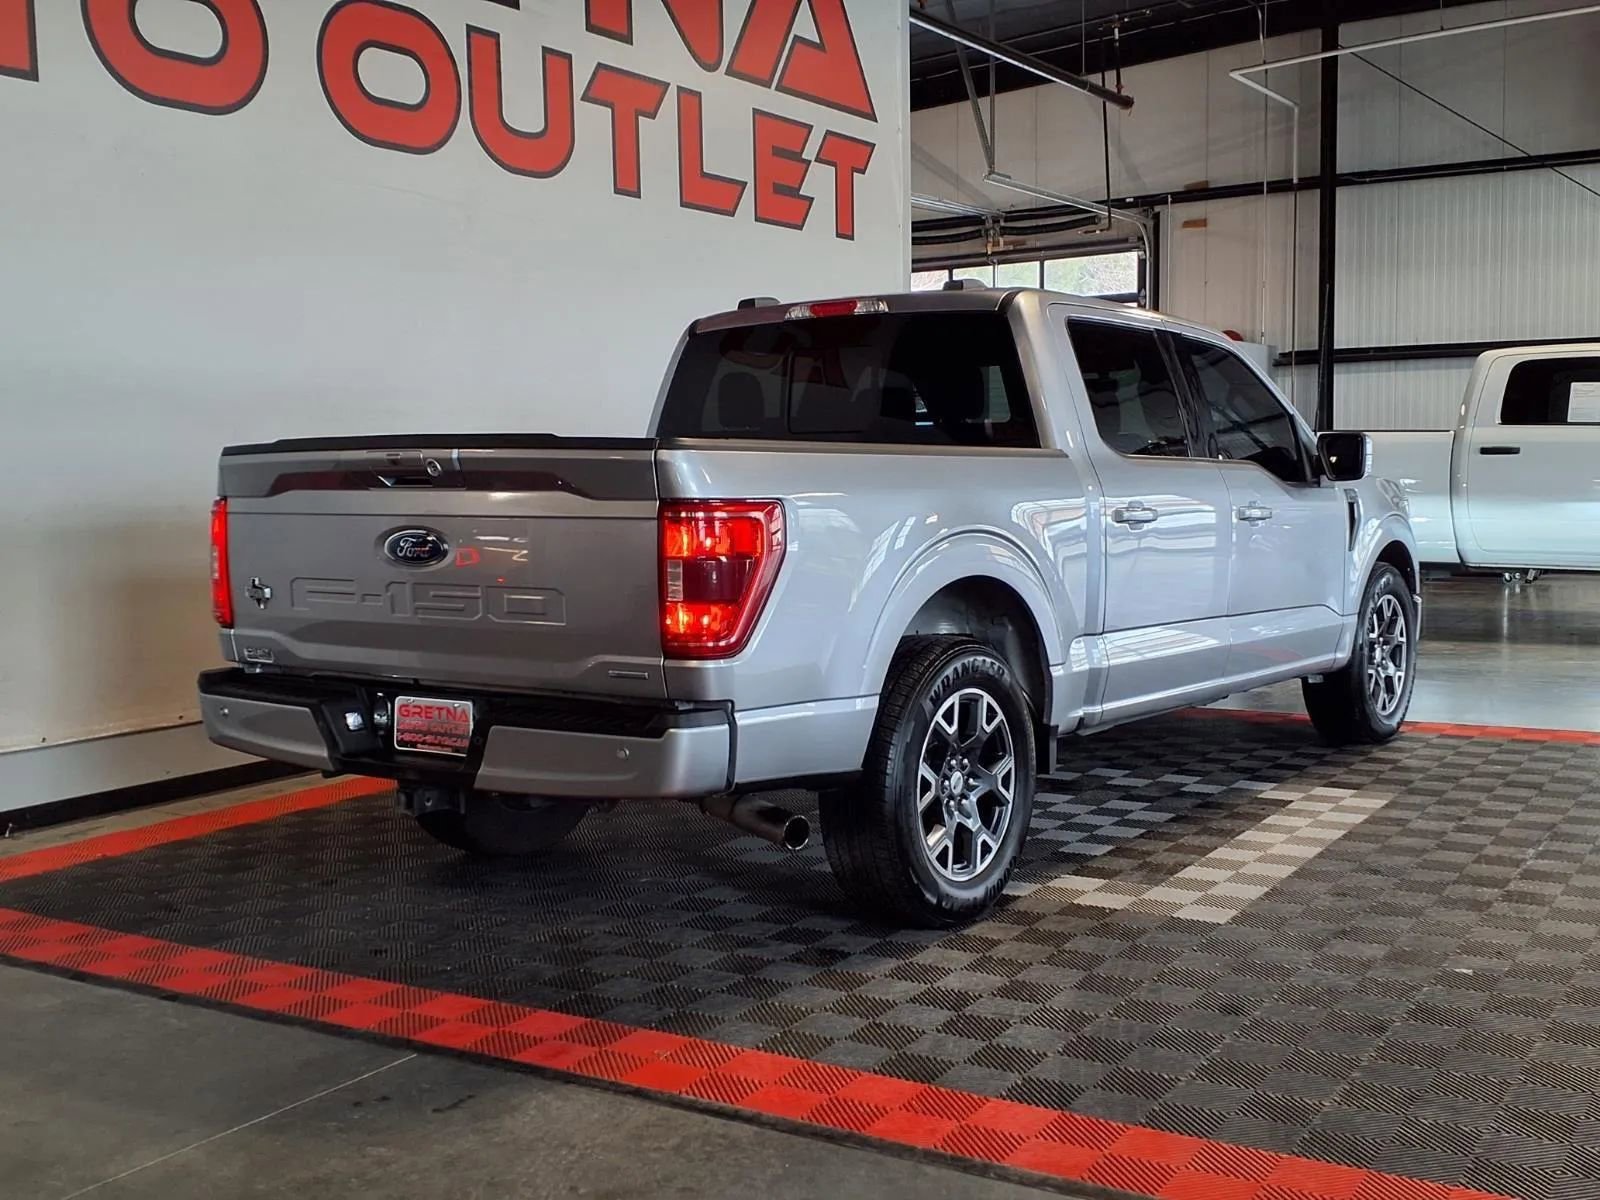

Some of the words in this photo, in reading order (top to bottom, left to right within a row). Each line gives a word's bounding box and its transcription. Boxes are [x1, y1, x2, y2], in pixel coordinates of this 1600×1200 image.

[317, 0, 876, 241] OUTLET
[396, 536, 433, 558] Ford
[289, 577, 567, 626] F-150
[929, 657, 1005, 708] WRANGLER
[398, 703, 469, 722] GRETNA
